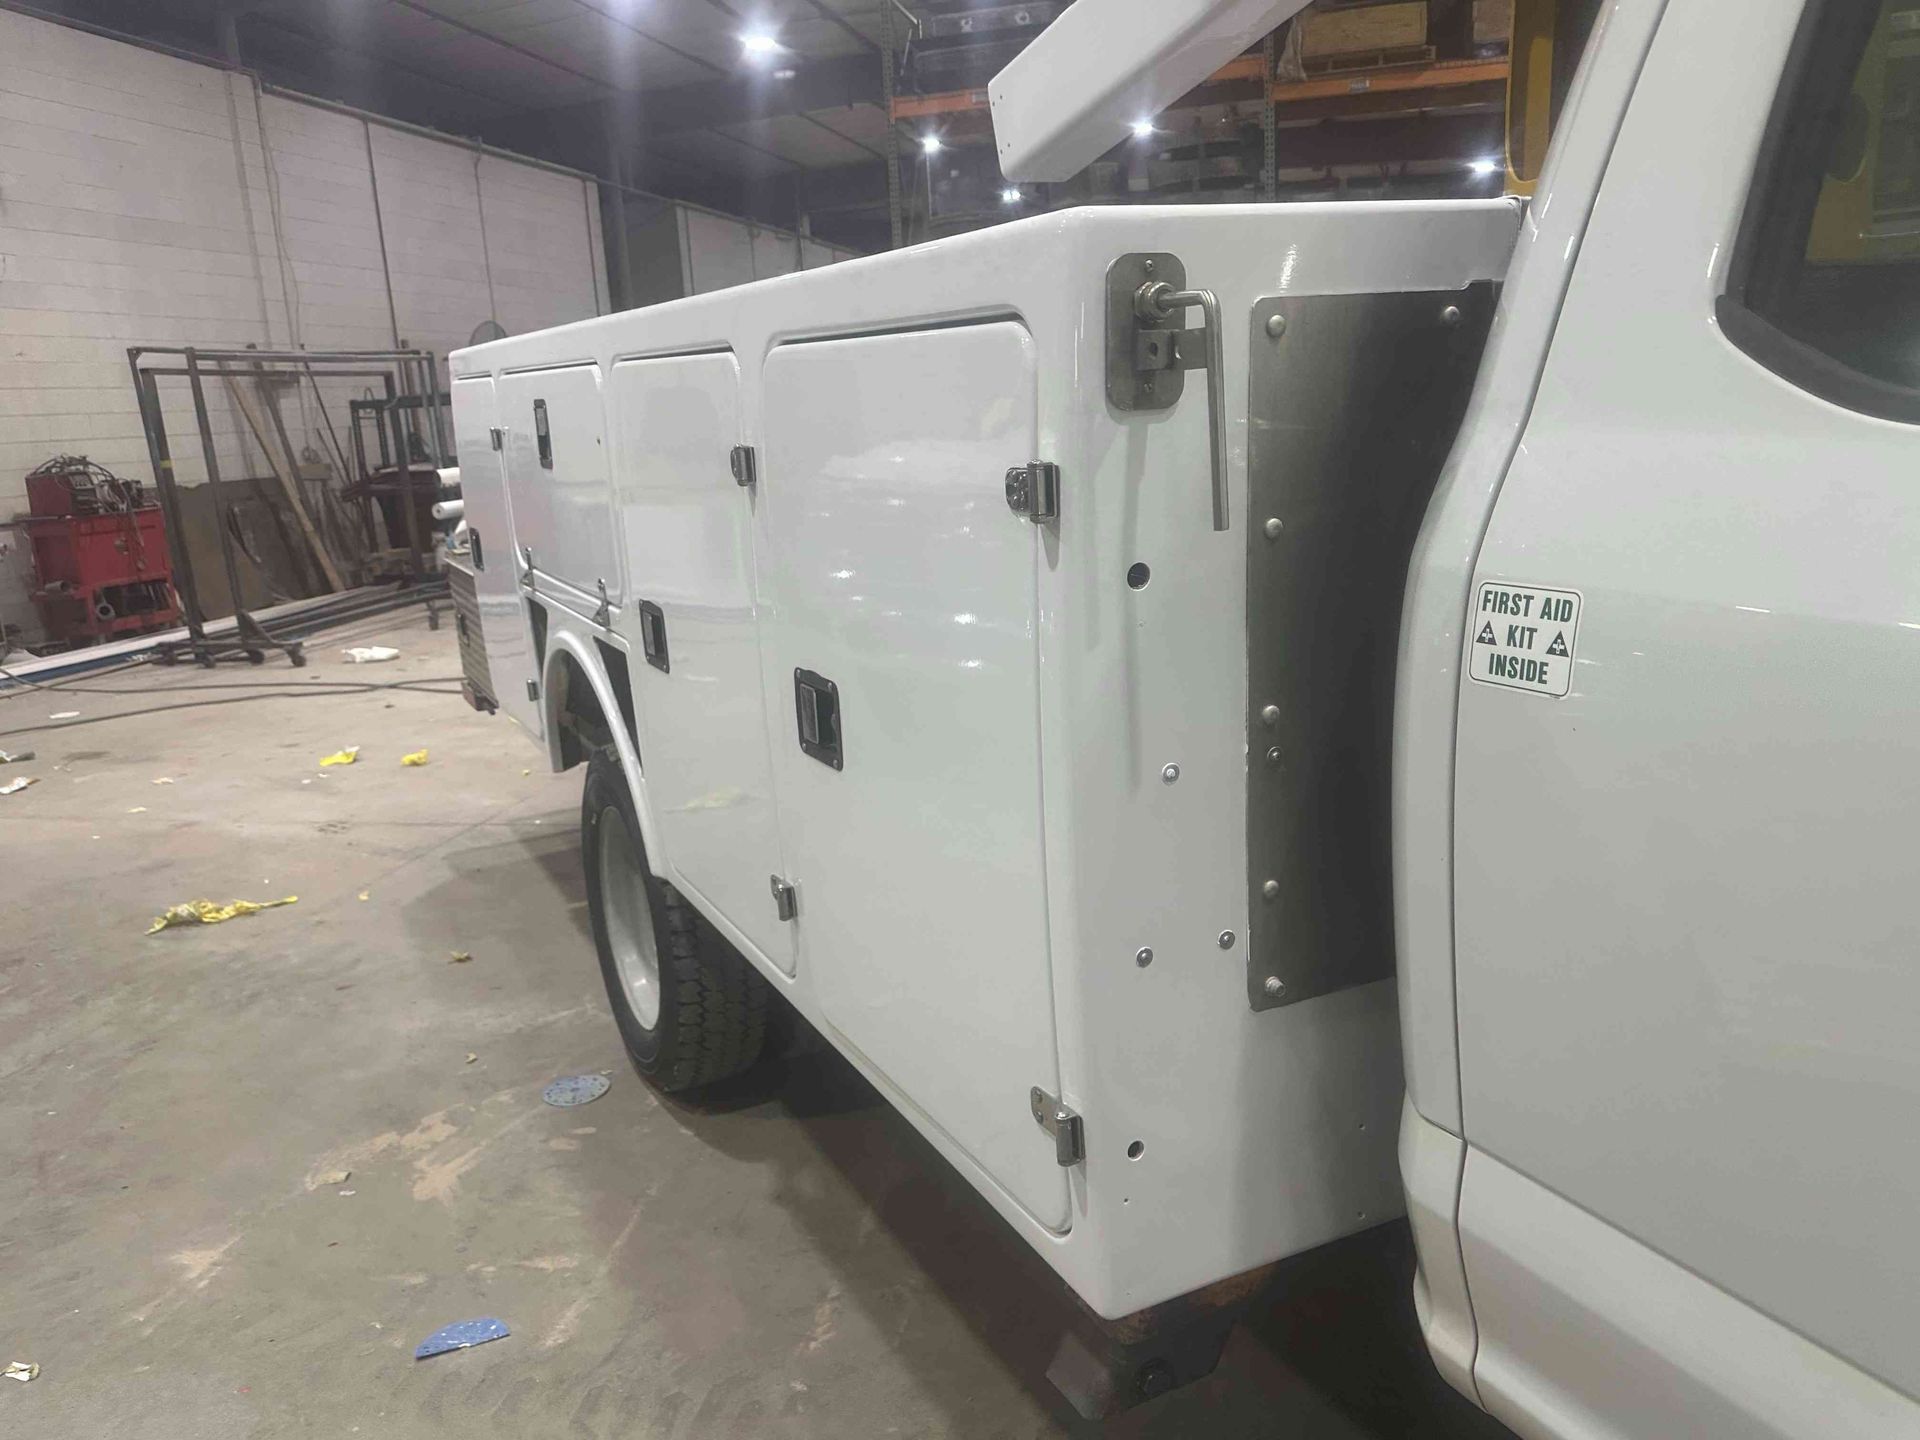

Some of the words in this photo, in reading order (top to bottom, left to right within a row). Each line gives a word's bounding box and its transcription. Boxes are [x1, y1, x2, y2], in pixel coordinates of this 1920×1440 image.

[1482, 590, 1534, 617] FIRST
[1540, 597, 1573, 623] AID
[1506, 624, 1538, 650] KIT
[1489, 653, 1549, 685] INSIDE
